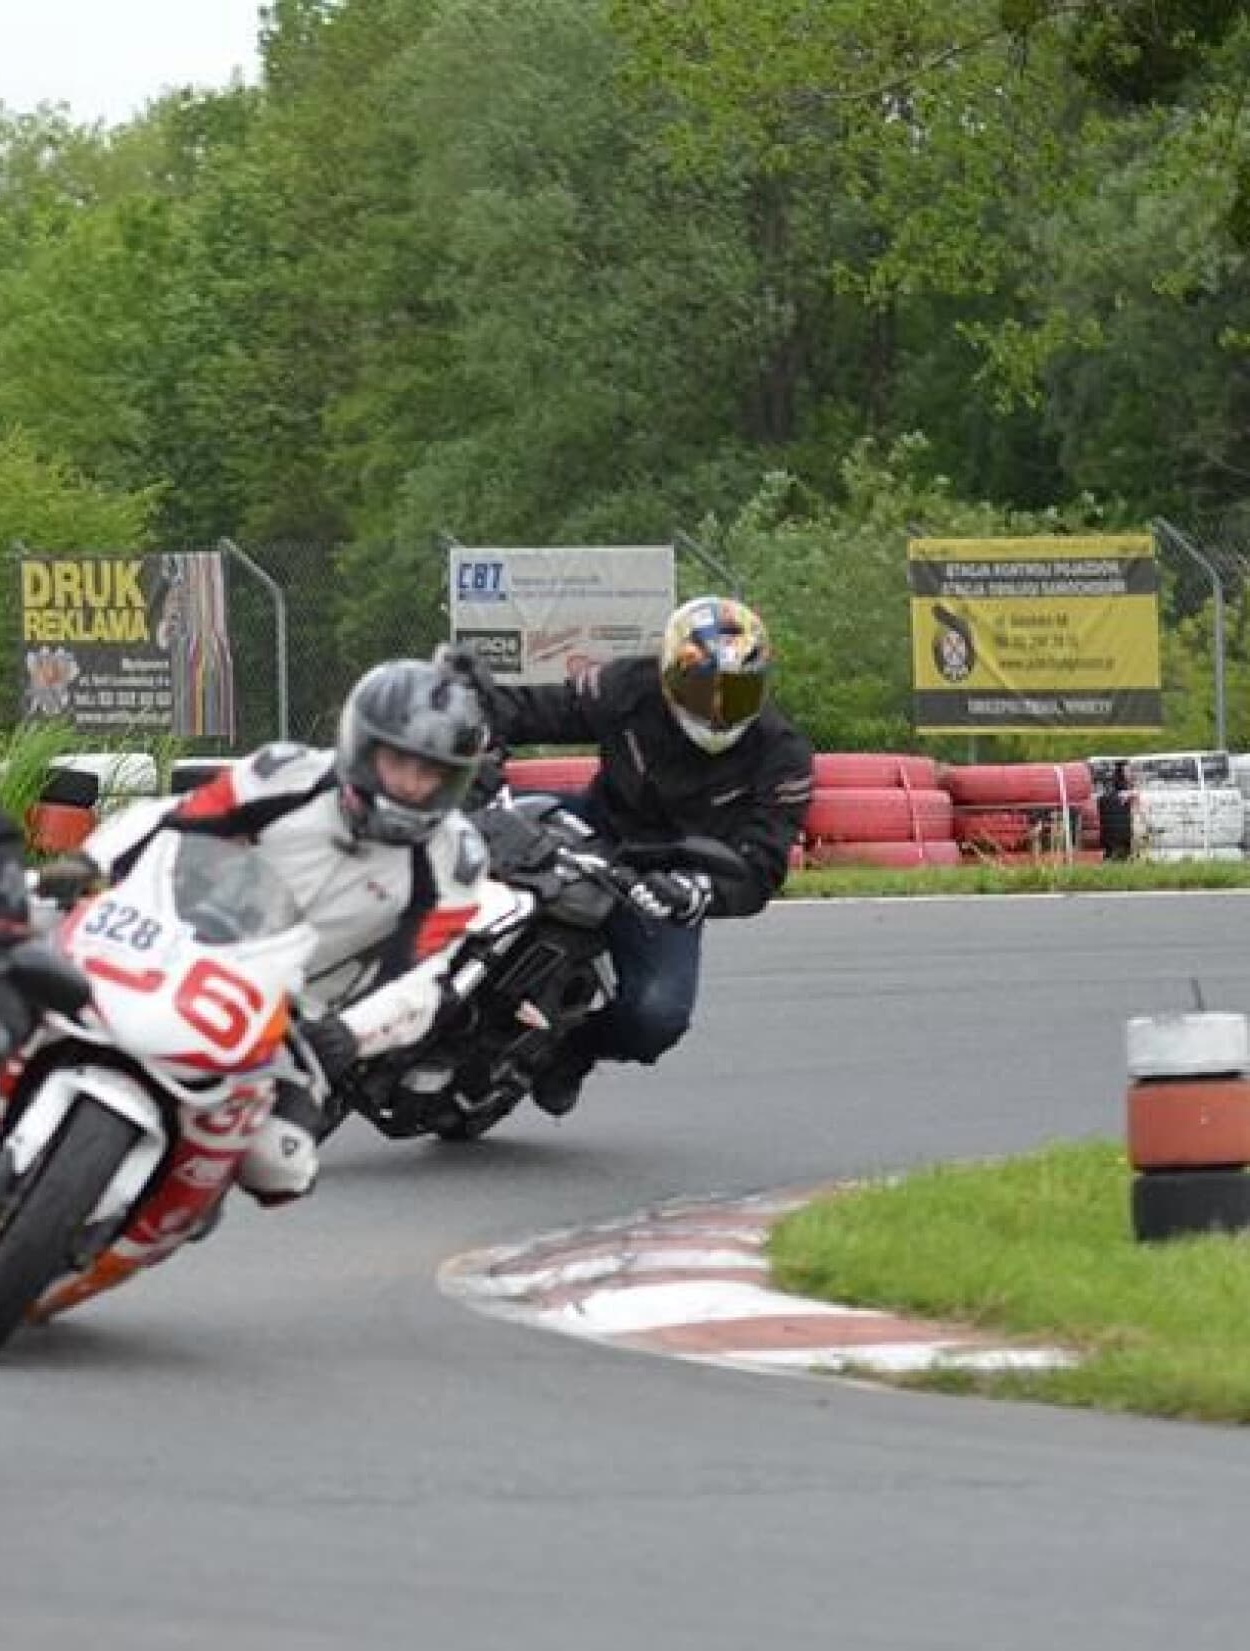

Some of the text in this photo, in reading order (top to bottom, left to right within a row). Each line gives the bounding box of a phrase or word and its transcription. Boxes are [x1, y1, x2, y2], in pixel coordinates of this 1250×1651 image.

[21, 560, 145, 608] DRUK
[459, 562, 504, 590] CBT
[24, 608, 151, 641] REKLAMA
[84, 902, 162, 952] 328
